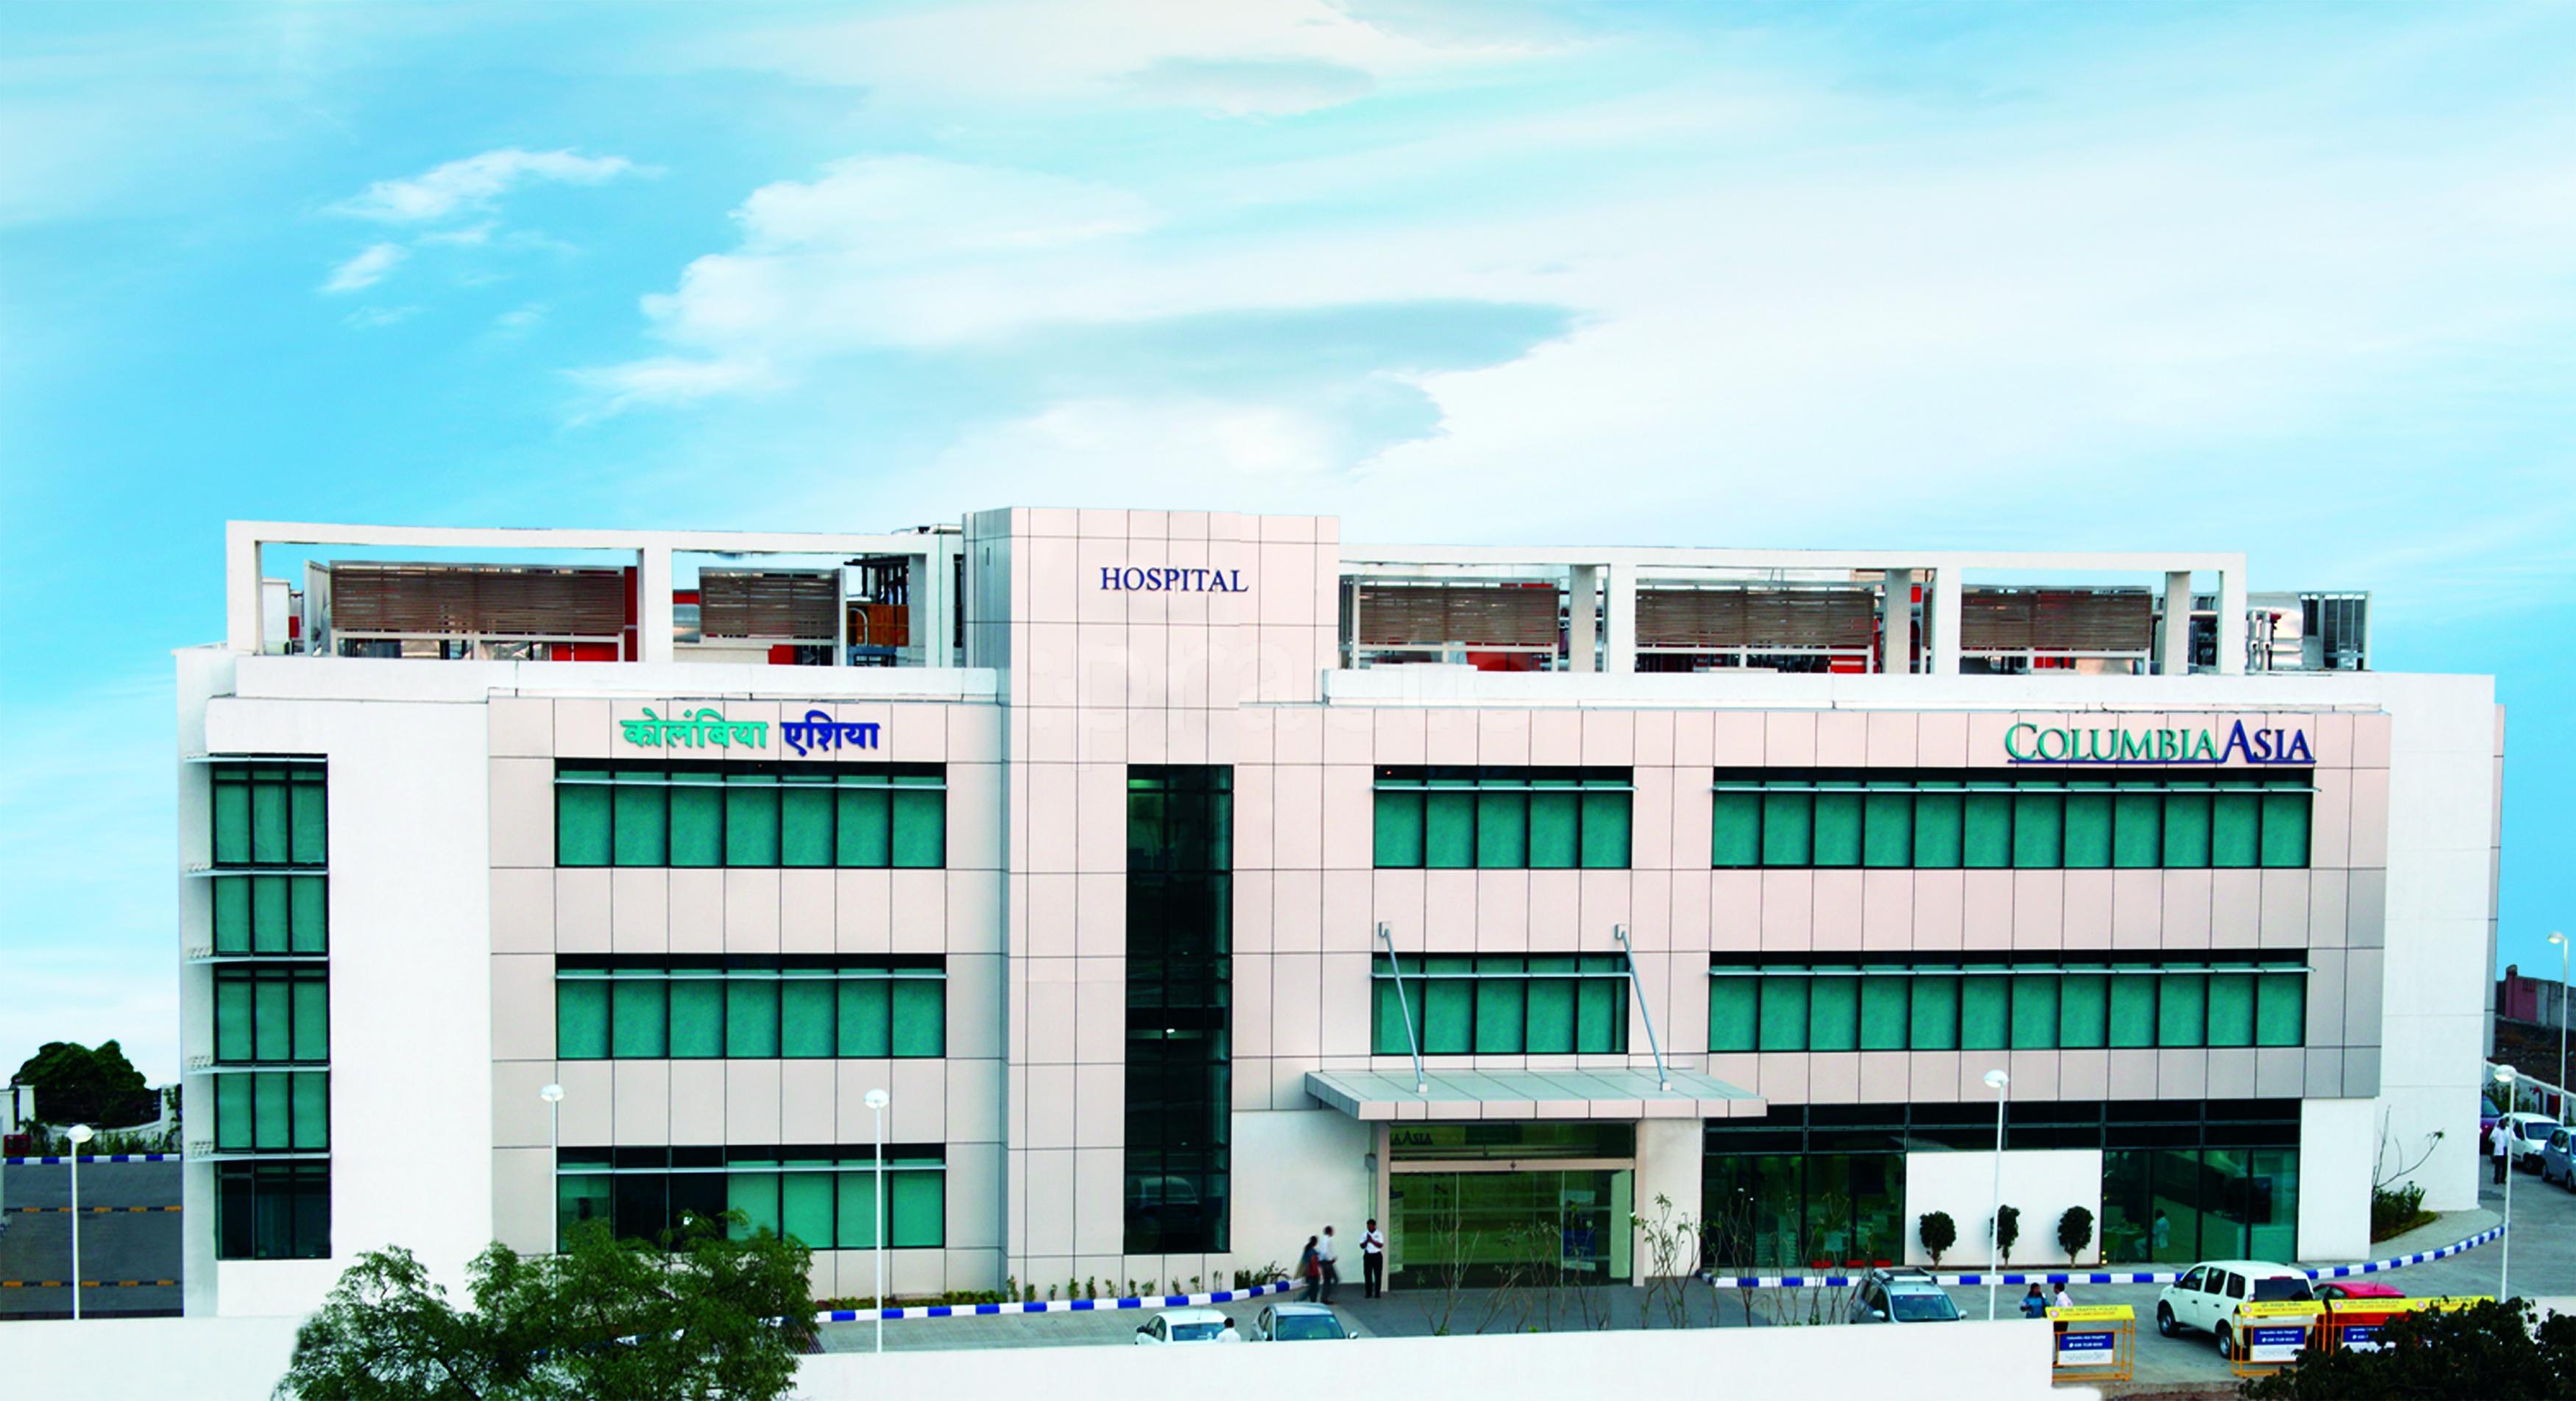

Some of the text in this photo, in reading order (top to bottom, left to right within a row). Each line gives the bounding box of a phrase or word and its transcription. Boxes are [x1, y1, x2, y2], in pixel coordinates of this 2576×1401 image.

[1101, 567, 1249, 593] HOSPITAL
[620, 707, 880, 756] कोलंबिया एशिया
